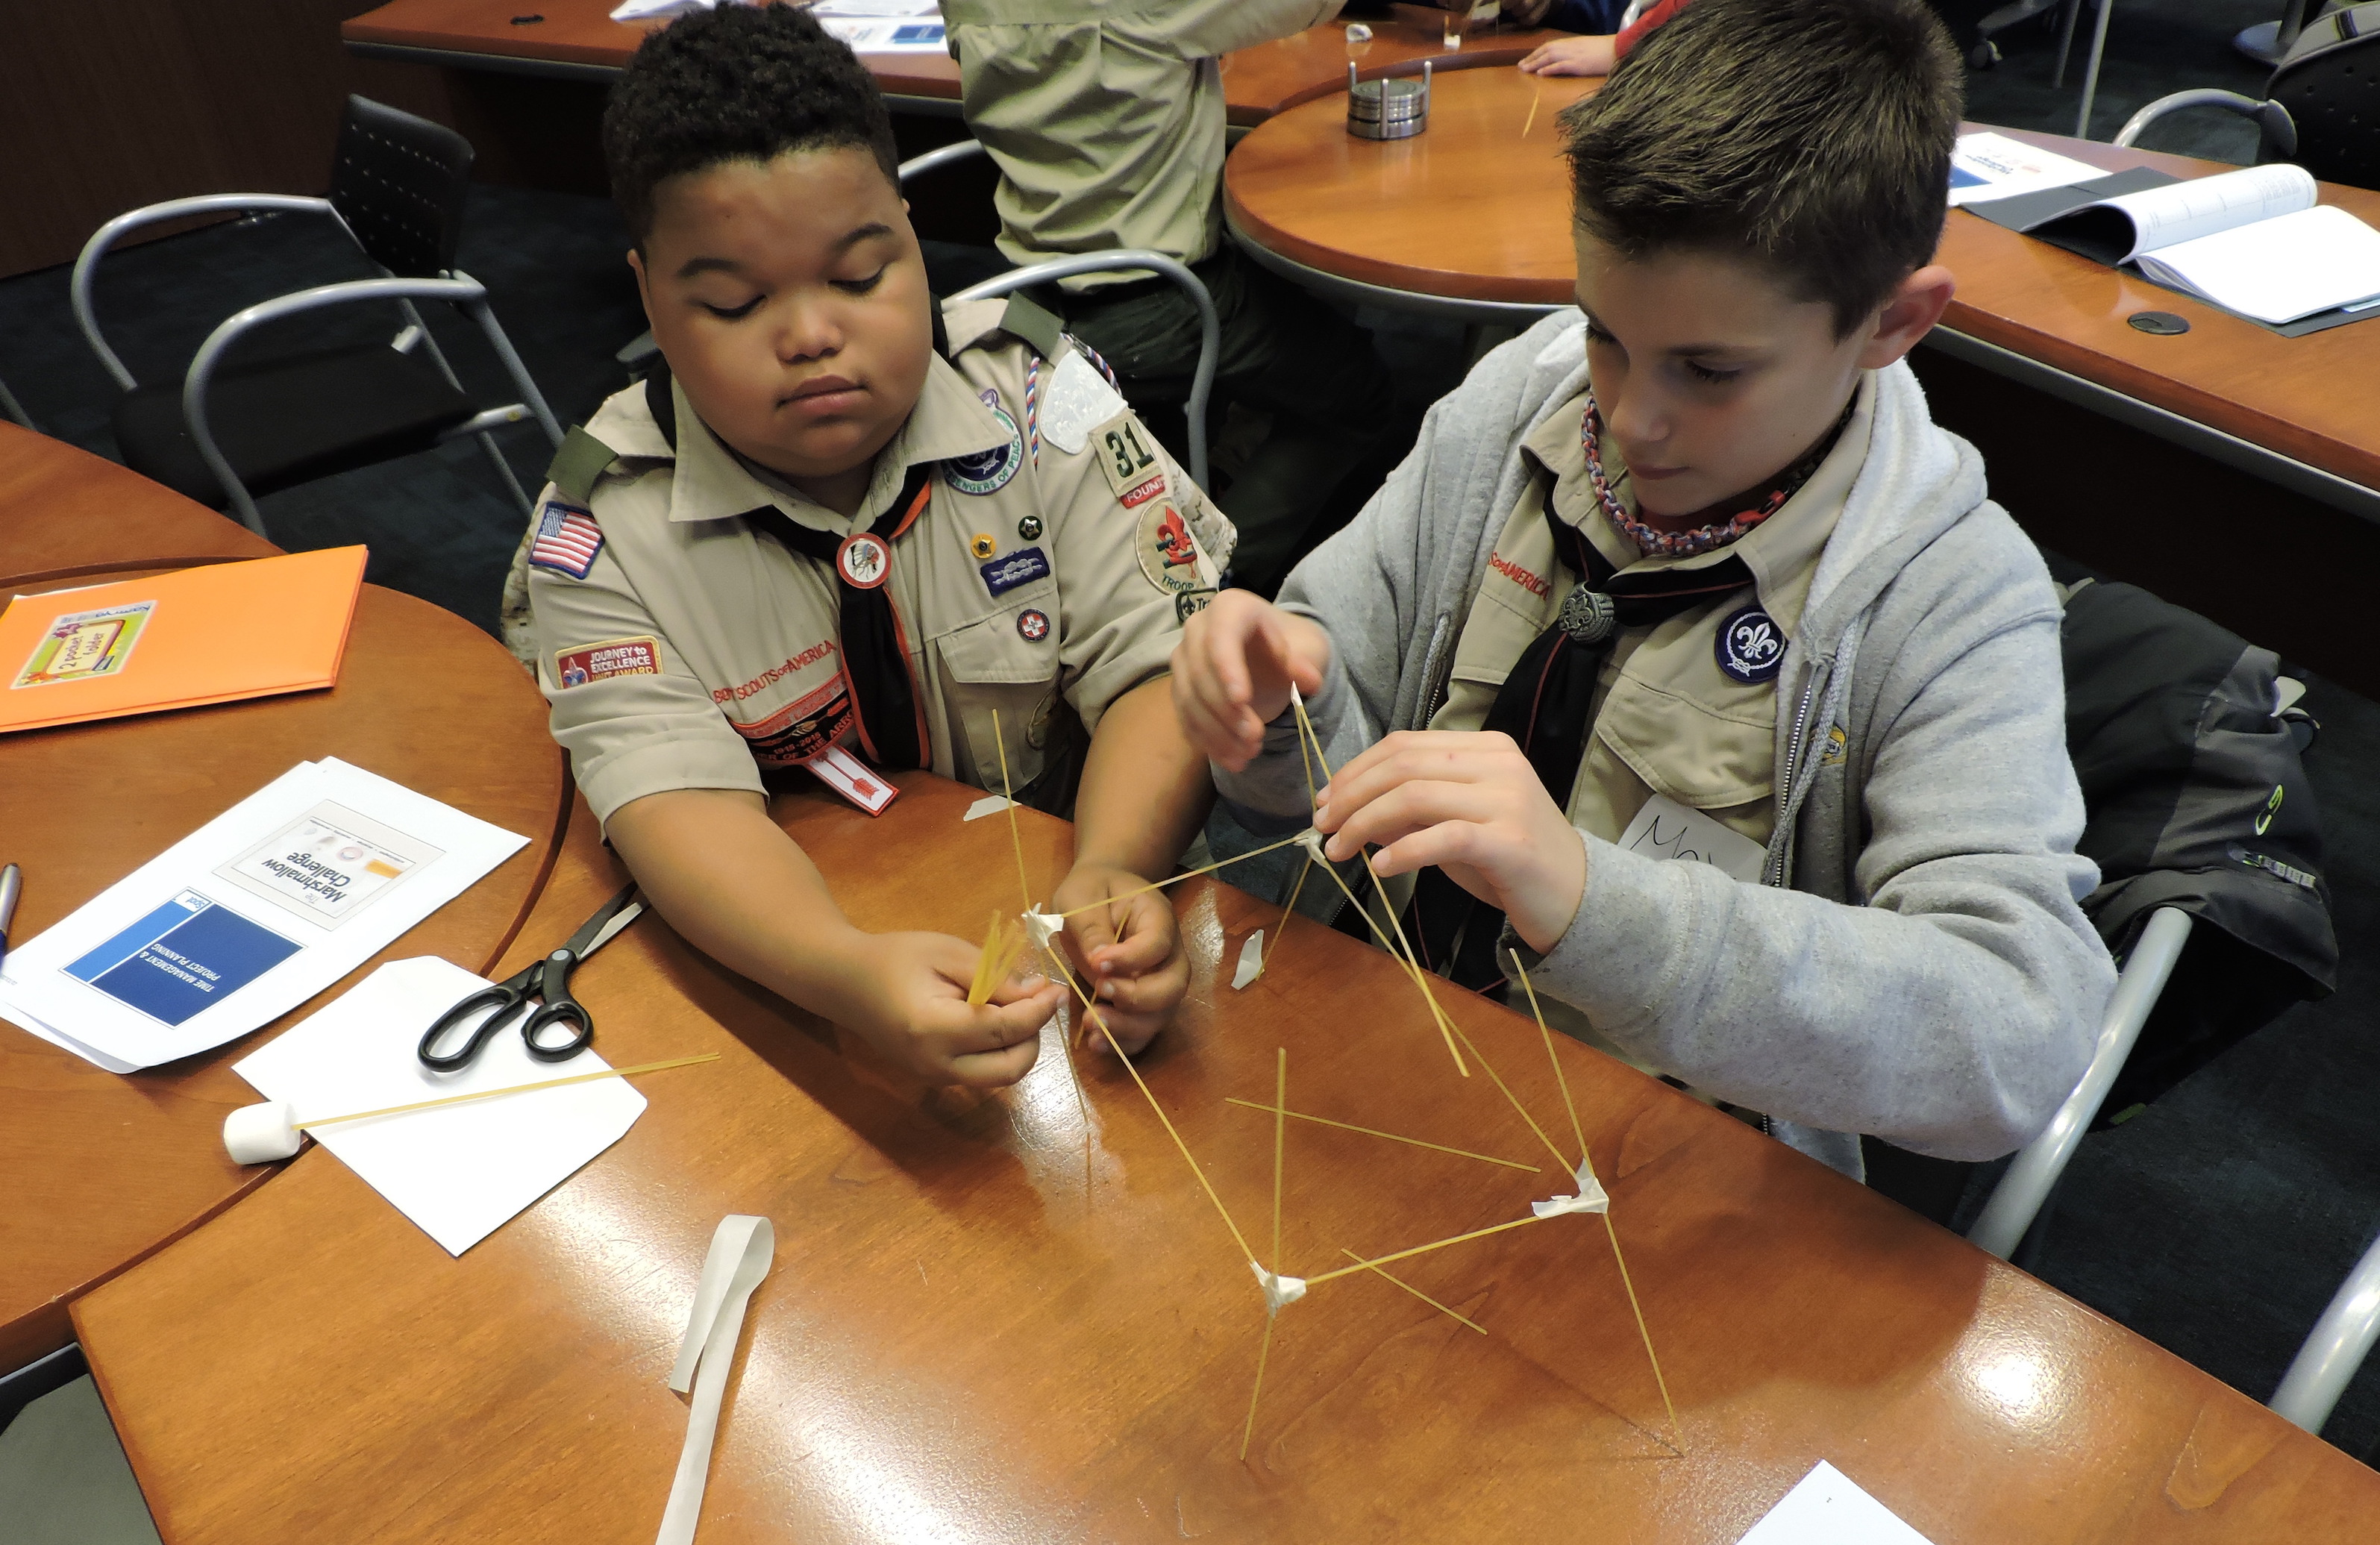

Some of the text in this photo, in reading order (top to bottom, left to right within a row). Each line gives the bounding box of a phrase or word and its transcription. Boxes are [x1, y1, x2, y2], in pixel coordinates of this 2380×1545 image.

[1105, 421, 1155, 478] 31
[998, 468, 1009, 483] OF
[1162, 574, 1194, 591] TROOP
[1502, 561, 1552, 601] AMERICA
[64, 635, 85, 662] pocket
[82, 632, 105, 656] folder
[589, 645, 647, 664] JOURNEY to
[58, 662, 78, 671] 2
[590, 655, 651, 674] EXCELLENCE
[614, 665, 654, 677] AWARD
[713, 687, 737, 704] BOY
[736, 668, 780, 701] SCOUTS
[786, 639, 837, 673] AMERICA
[783, 751, 800, 760] OF
[803, 736, 827, 756] THE
[260, 858, 348, 903] Marshmallow
[286, 852, 351, 888] Challenge
[185, 896, 206, 909] Spot
[139, 950, 216, 993] TIME MANAGEMENT &
[151, 943, 222, 982] PROJECT PLANNING
